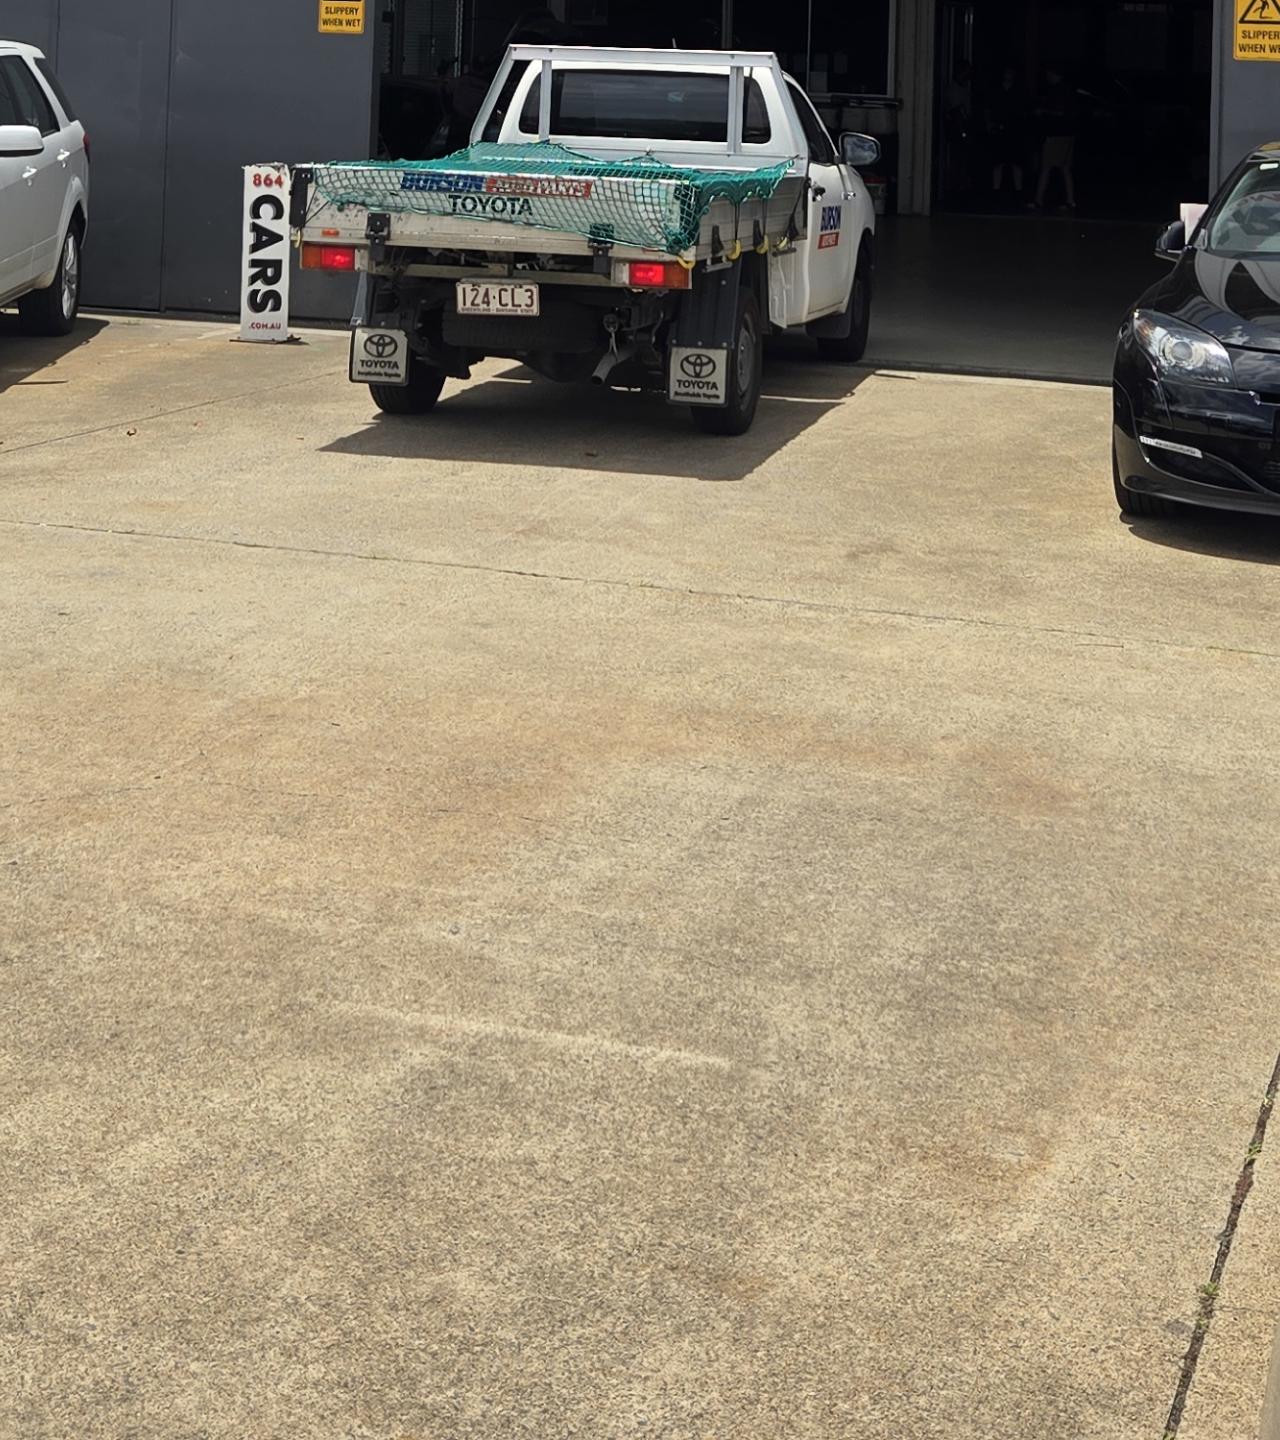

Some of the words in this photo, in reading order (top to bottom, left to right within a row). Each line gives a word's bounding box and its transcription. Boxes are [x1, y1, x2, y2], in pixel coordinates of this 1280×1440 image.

[324, 6, 360, 16] SLIPPERY
[321, 18, 344, 27] WHEN
[345, 18, 361, 28] WET
[1238, 43, 1266, 53] WHEN
[252, 173, 284, 189] 864
[447, 194, 534, 217] TOYOTA
[247, 193, 285, 314] CARS
[248, 321, 282, 330] .COM.AU
[360, 359, 400, 371] TOYOTA
[676, 379, 719, 391] TOYOTA
